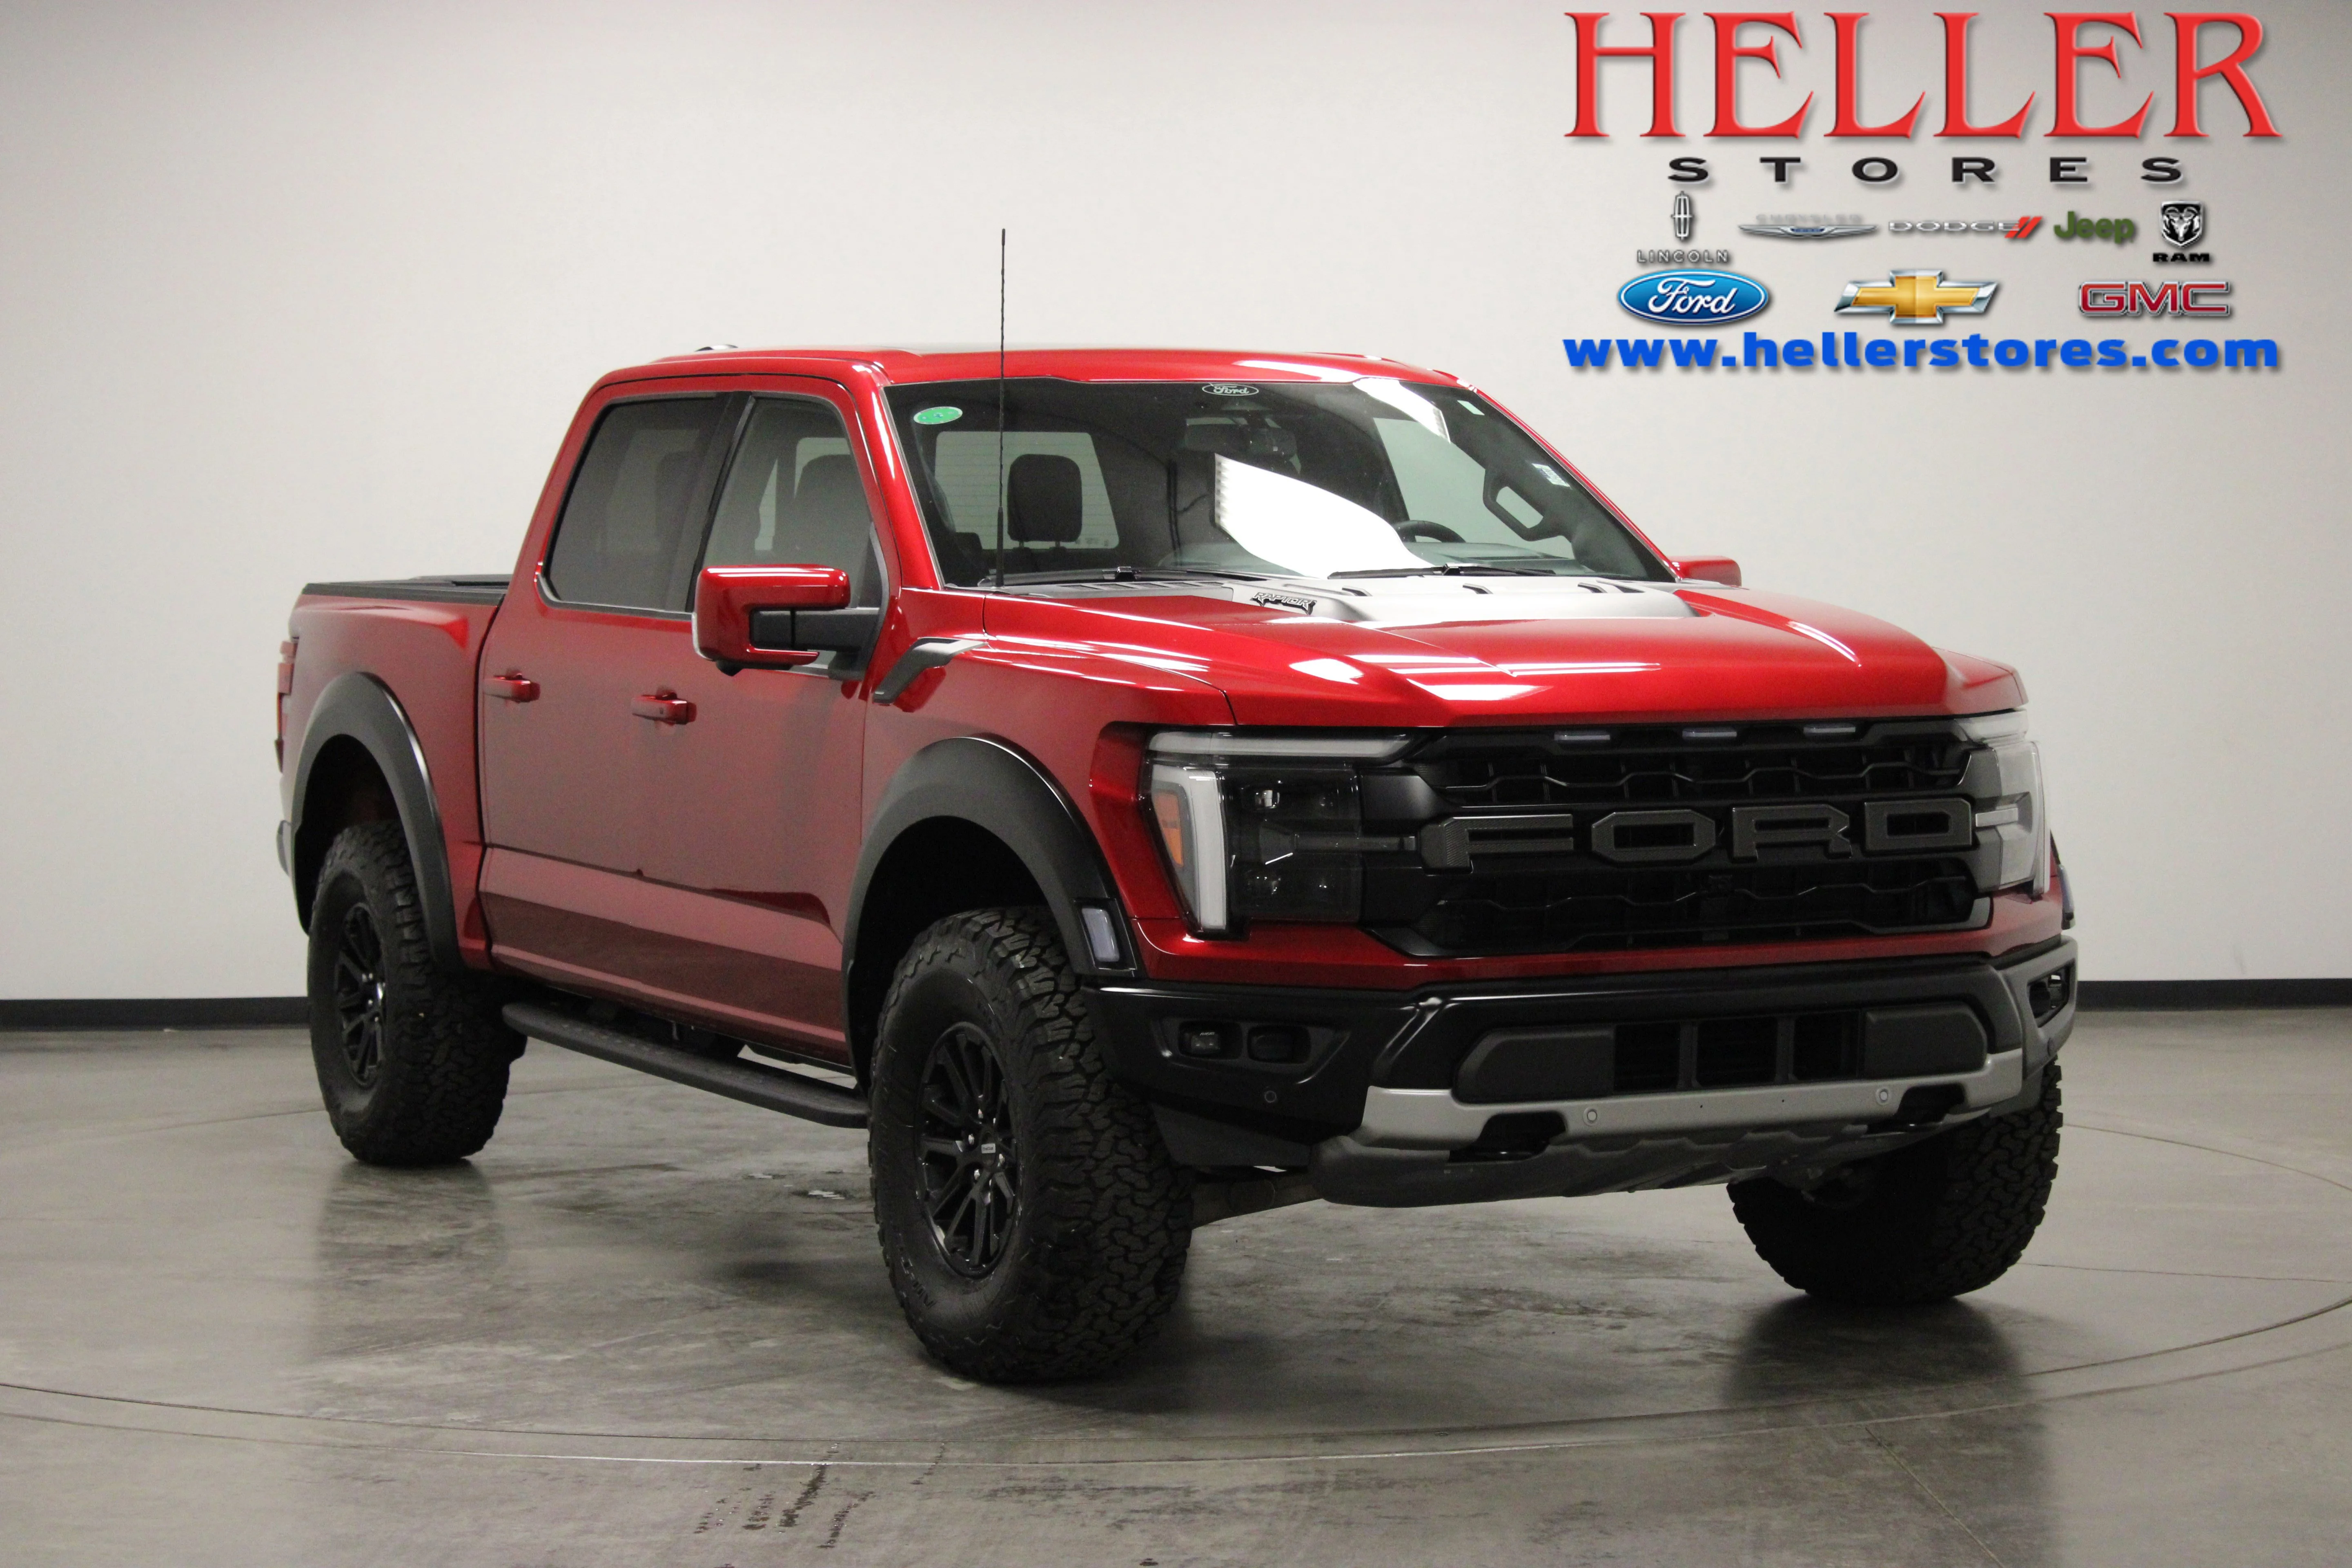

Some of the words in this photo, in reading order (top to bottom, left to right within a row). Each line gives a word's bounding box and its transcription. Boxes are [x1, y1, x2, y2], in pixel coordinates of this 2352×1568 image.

[1213, 385, 1250, 394] Ford
[1250, 592, 1317, 615] RAPTOR
[1420, 798, 1972, 875] FORD
